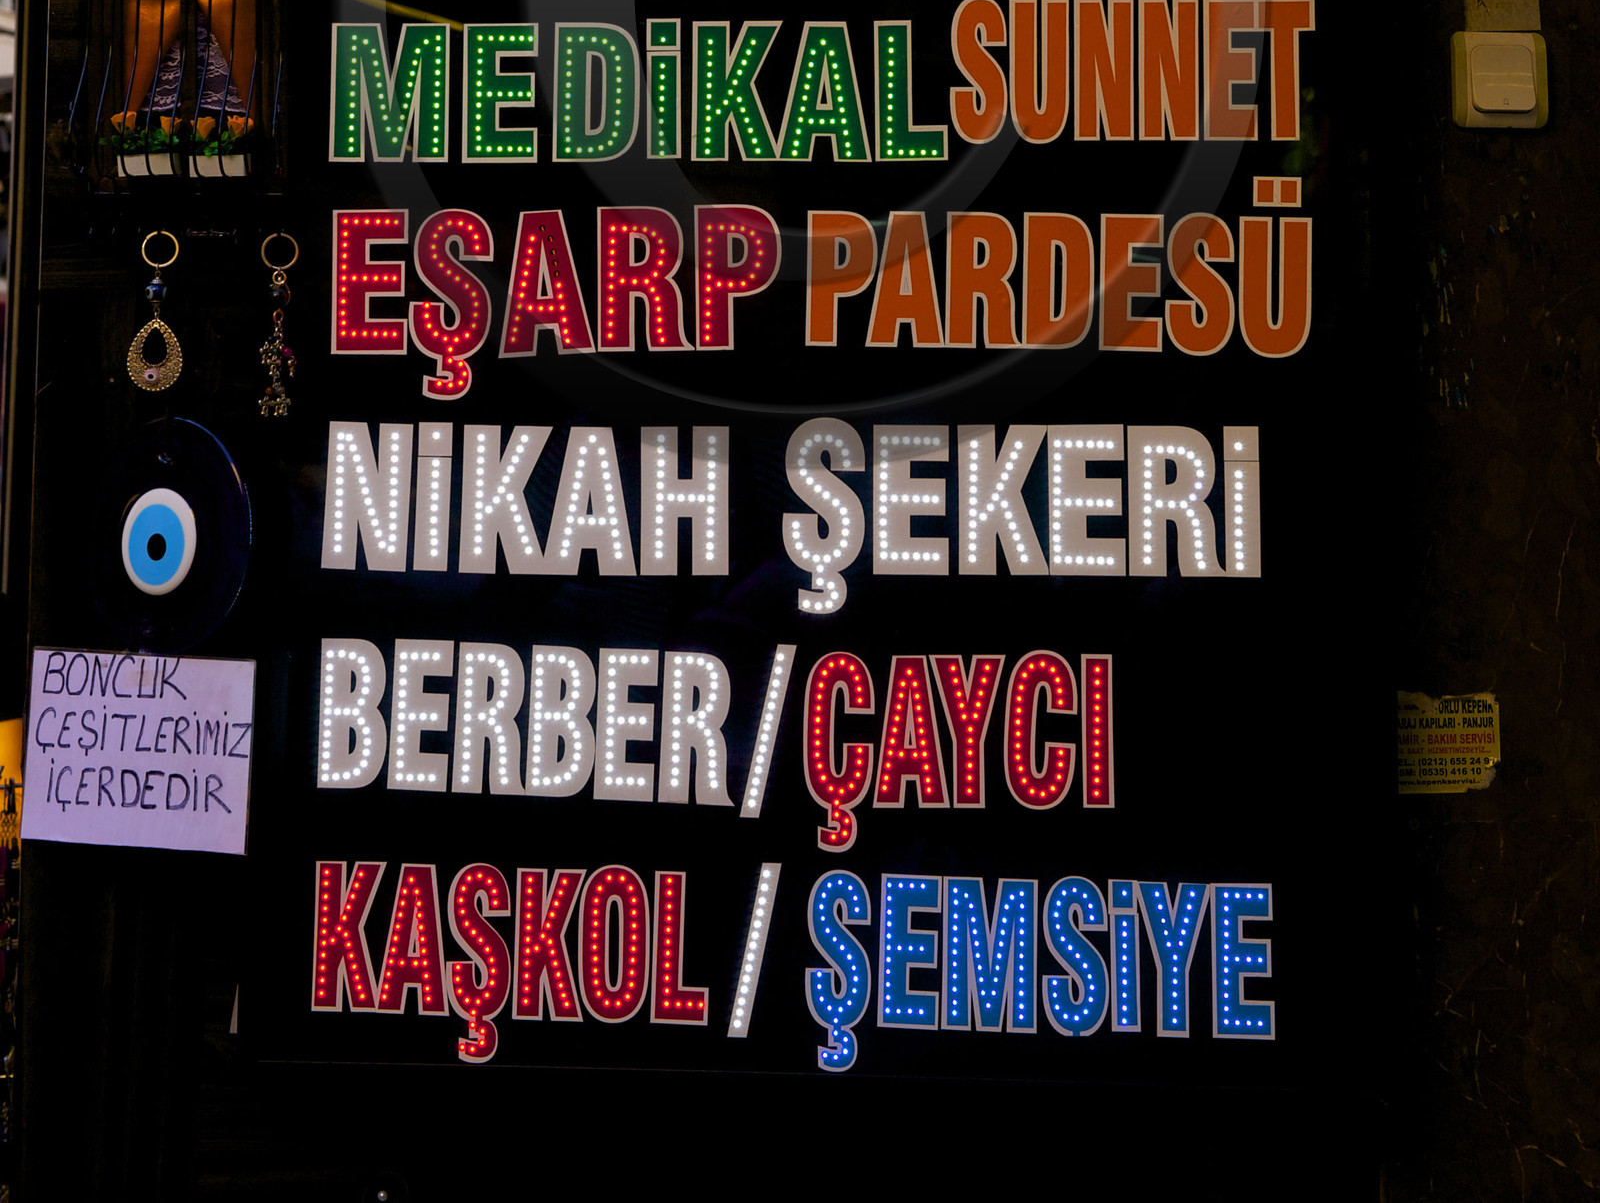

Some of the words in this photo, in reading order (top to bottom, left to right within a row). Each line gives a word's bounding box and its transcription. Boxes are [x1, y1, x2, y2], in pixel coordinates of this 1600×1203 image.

[330, 203, 783, 401] EŞARP
[804, 176, 1314, 358] PARDESÜ
[43, 651, 187, 701] BONCUK
[35, 704, 253, 759] ÇEŞİTLERİMİZ
[1427, 734, 1457, 745] BAKIM
[1463, 717, 1494, 728] PANJUR
[46, 758, 232, 814] İÇERDEDİR
[310, 860, 710, 1063] KAŞKOL
